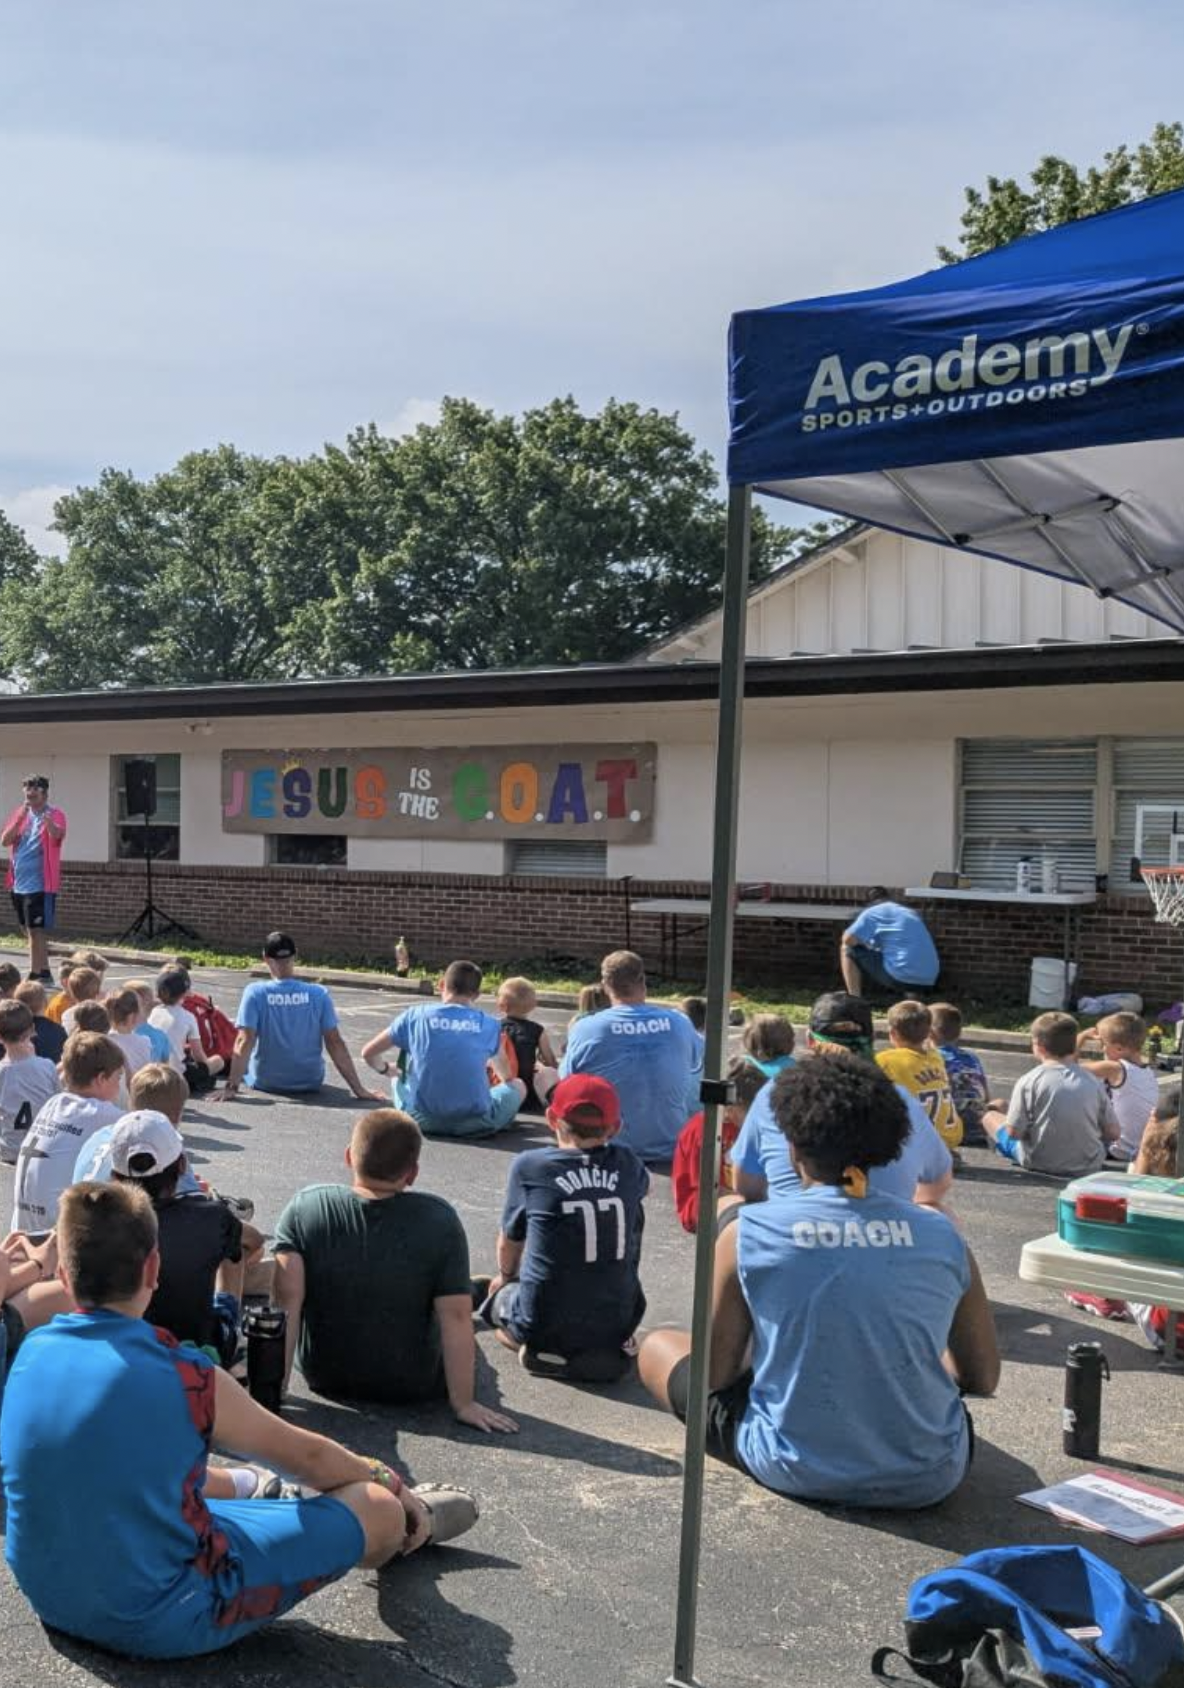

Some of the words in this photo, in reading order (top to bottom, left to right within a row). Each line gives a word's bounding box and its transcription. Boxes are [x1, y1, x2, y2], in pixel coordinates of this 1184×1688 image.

[803, 324, 1134, 410] Academy
[801, 379, 1089, 432] SPORTS+OUTDOORS
[224, 764, 387, 819] JESUS
[410, 767, 431, 790] IS
[452, 759, 641, 824] G.O.A.T.
[399, 792, 439, 820] THE
[267, 991, 309, 1006] COACH
[429, 1017, 482, 1033] COACH
[611, 1018, 671, 1035] COACH
[14, 1101, 33, 1130] 4
[562, 1197, 626, 1262] 77
[792, 1220, 914, 1249] COACH
